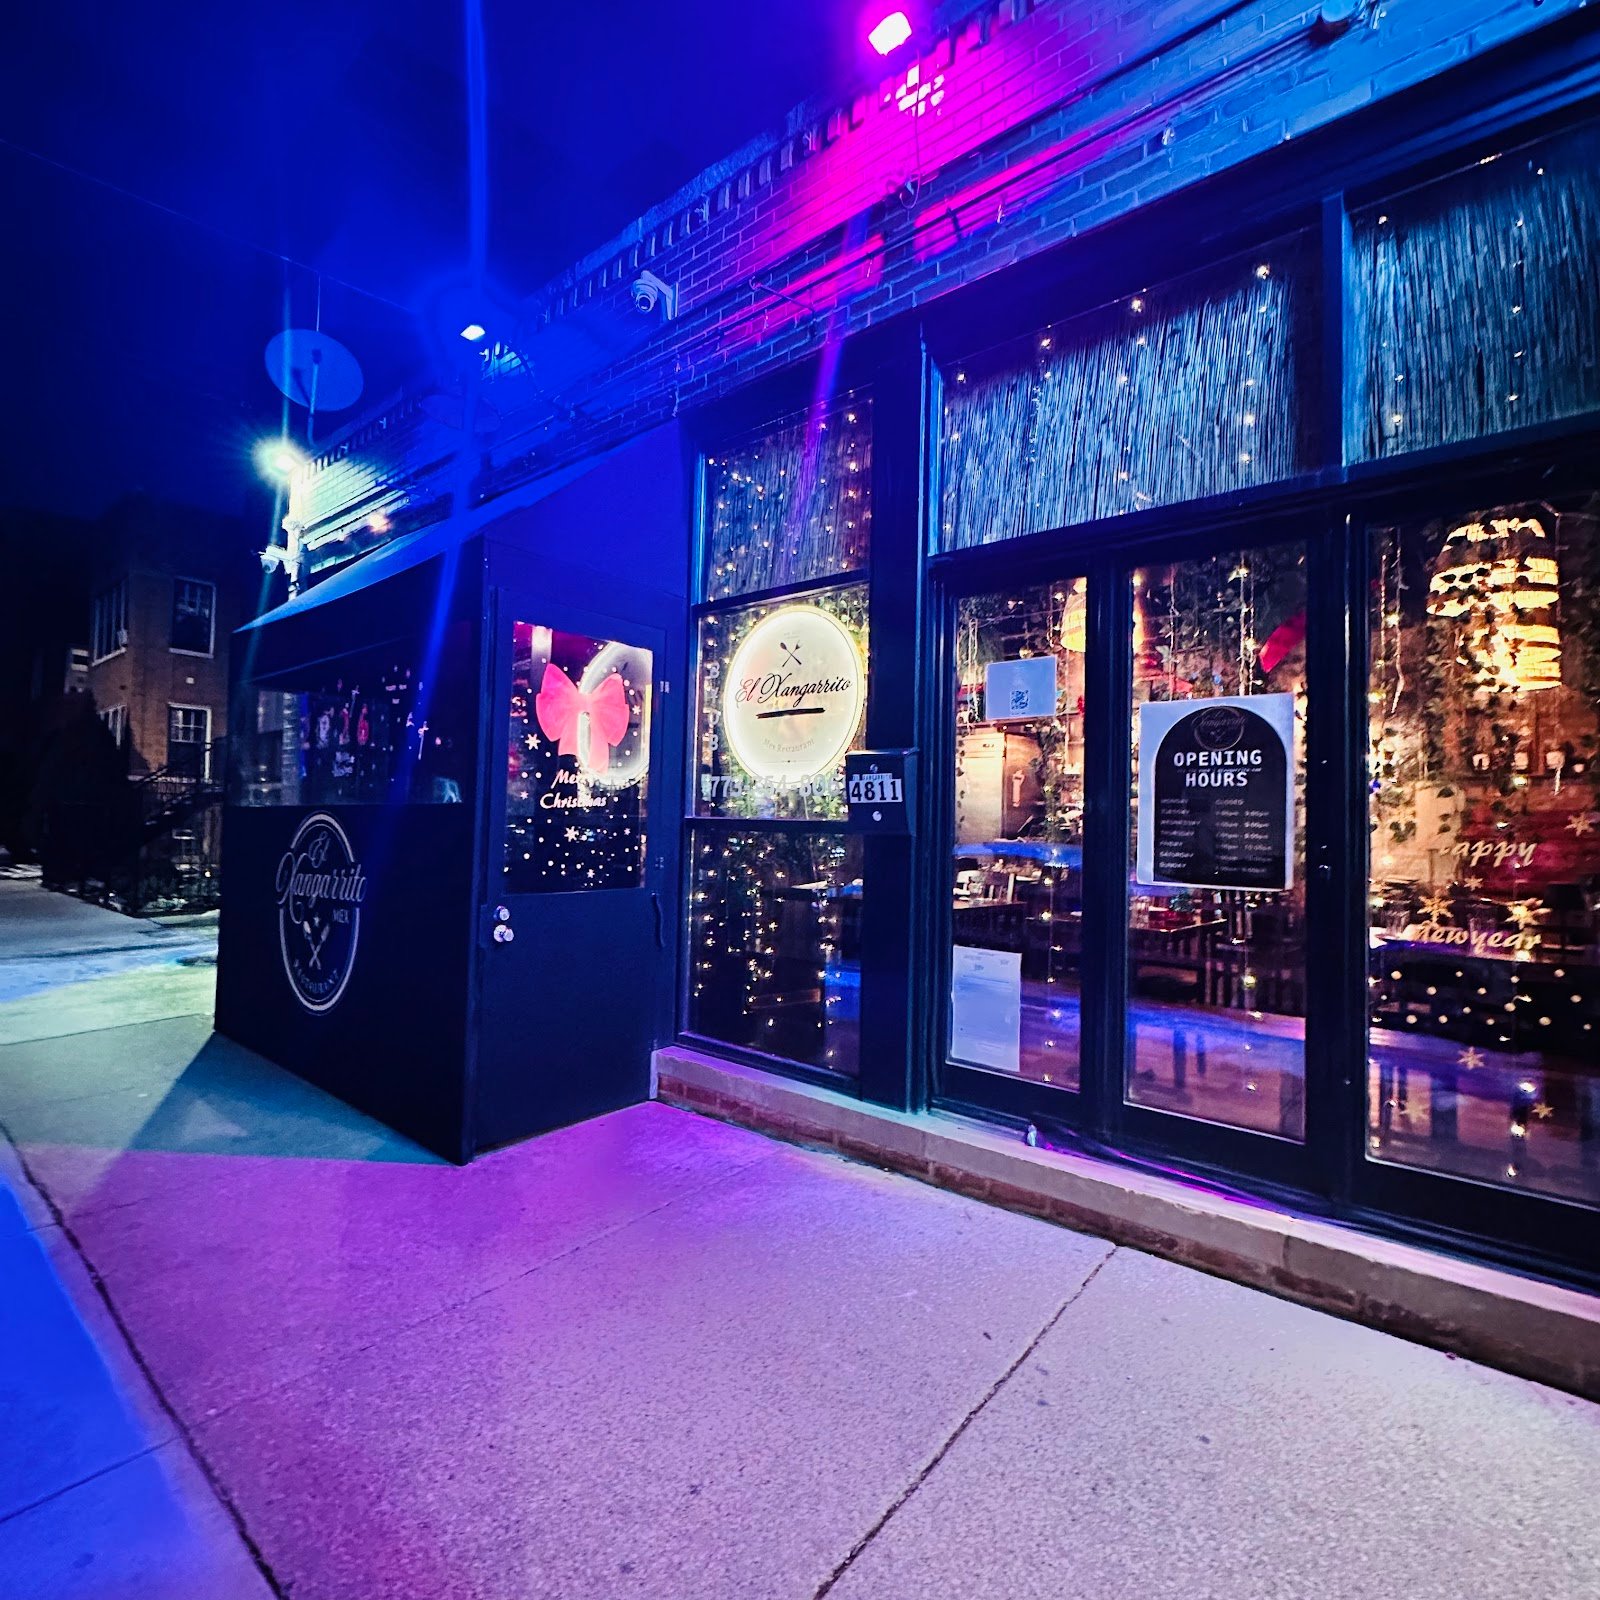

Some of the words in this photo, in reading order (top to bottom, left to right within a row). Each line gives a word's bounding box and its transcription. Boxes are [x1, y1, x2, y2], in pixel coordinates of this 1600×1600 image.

[734, 677, 761, 708] El
[757, 672, 853, 708] Xangarrito
[1173, 749, 1262, 767] OPENING
[1185, 771, 1248, 787] HOURS
[851, 780, 899, 801] 4811
[1437, 840, 1538, 868] appy
